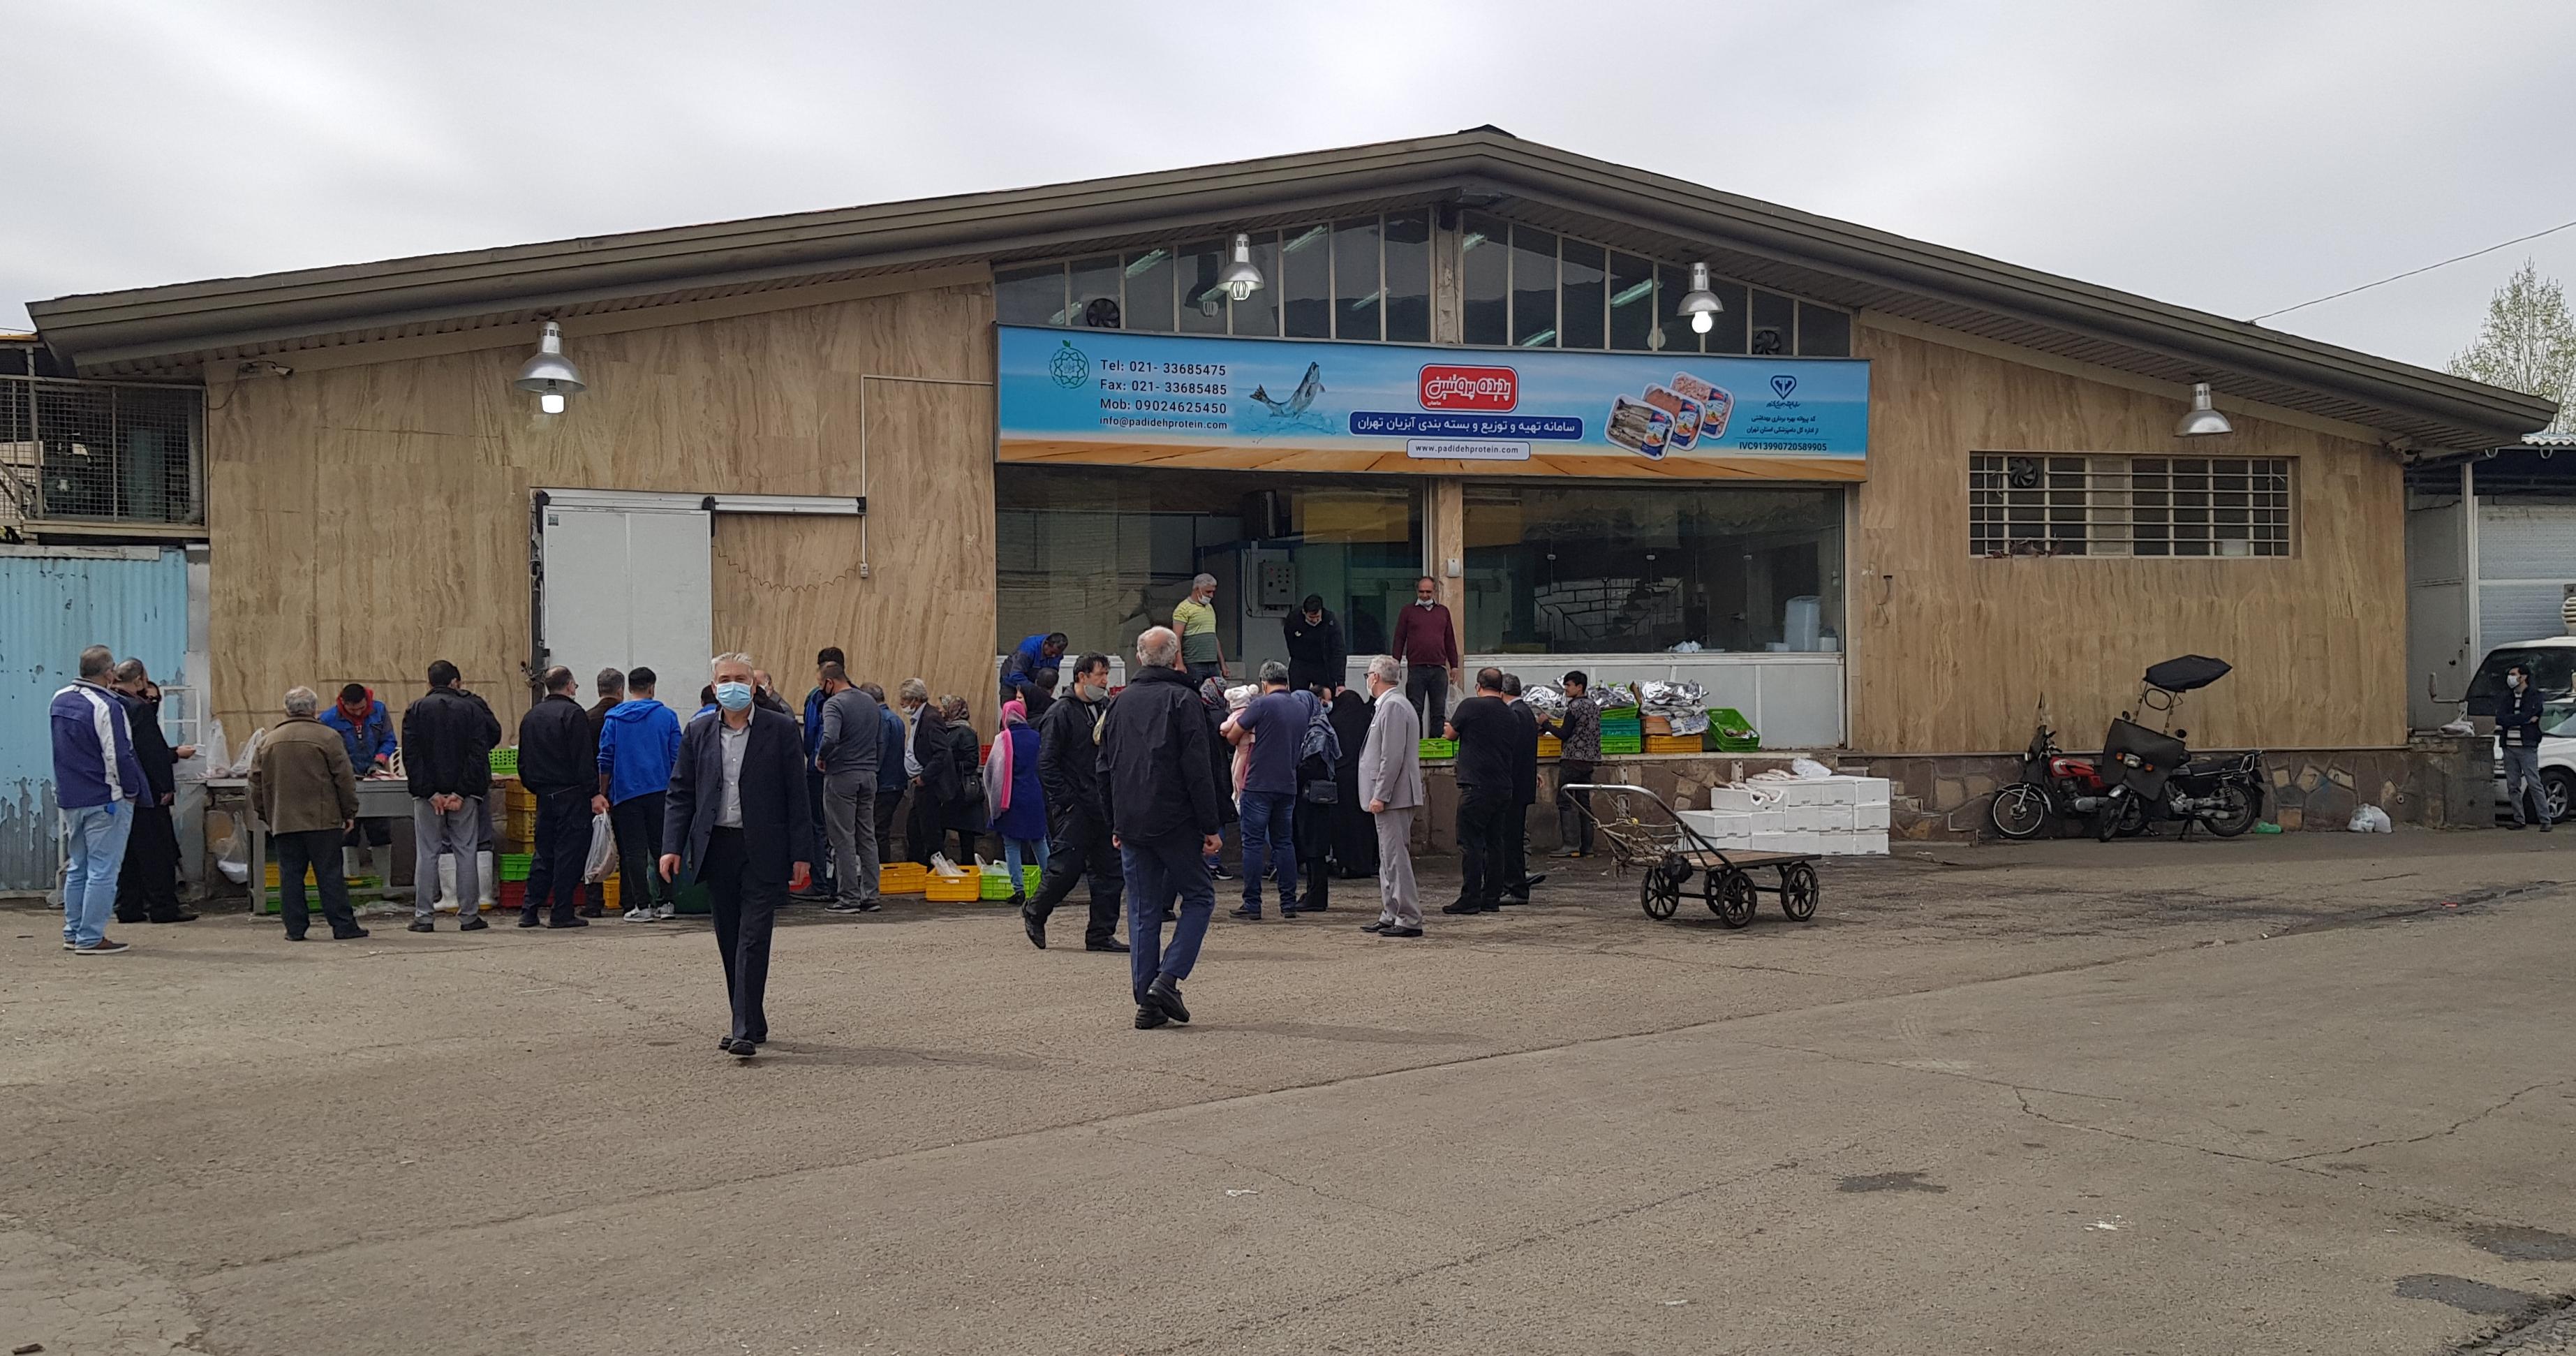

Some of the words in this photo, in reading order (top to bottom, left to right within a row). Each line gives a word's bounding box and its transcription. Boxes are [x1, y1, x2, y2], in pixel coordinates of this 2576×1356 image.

[1100, 360, 1124, 371] Tel:
[1130, 361, 1157, 372] 021-
[1163, 363, 1226, 376] 33685475
[1100, 379, 1126, 390] Fax:
[1132, 381, 1160, 391] 021-
[1165, 382, 1227, 395] 33685485
[1476, 378, 1511, 401] پدیده
[1100, 399, 1130, 410] Mob:
[1135, 399, 1227, 413] 09024625450
[1100, 416, 1227, 429] info@padidehprotein.com
[1358, 417, 1384, 430] تهران
[1386, 417, 1416, 431] آبزیان
[1419, 420, 1442, 432] بندی
[1444, 420, 1470, 432] بسته
[1472, 423, 1478, 432] و
[1481, 420, 1507, 434] توزیع
[1510, 424, 1516, 433] و
[1518, 422, 1541, 434] تهیه
[1544, 422, 1575, 432] سامانه
[1415, 444, 1519, 454] www.padidehprotein.com
[1739, 442, 1827, 451] IVC913990720589905
